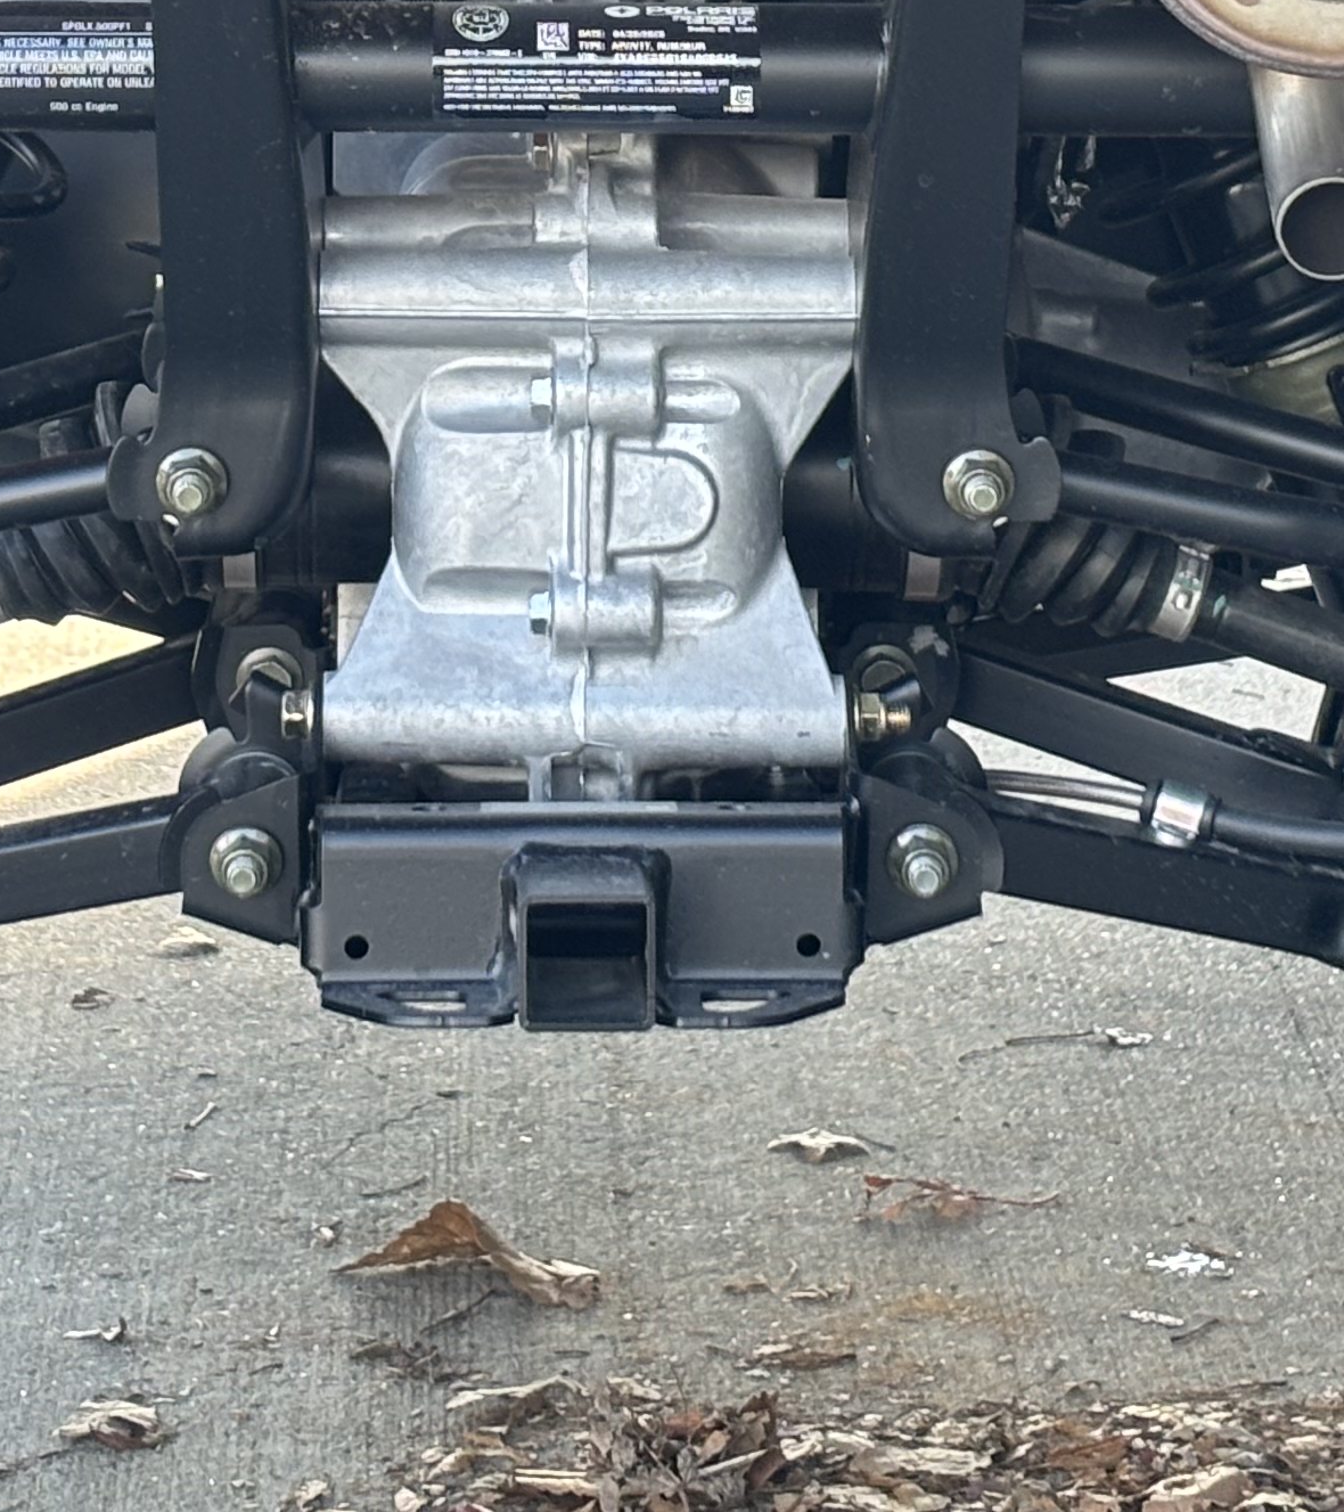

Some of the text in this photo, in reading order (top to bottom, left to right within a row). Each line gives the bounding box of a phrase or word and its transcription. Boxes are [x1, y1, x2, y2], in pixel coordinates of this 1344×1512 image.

[645, 6, 756, 16] POLARIS
[67, 37, 86, 48] SEE
[106, 50, 127, 61] AND
[20, 63, 86, 74] REGULATIONS
[89, 63, 109, 74] FOR
[112, 63, 147, 74] MODEL
[44, 76, 57, 88] TO
[60, 76, 104, 88] OPERATE
[107, 76, 122, 88] ON
[85, 101, 119, 113] Engine
